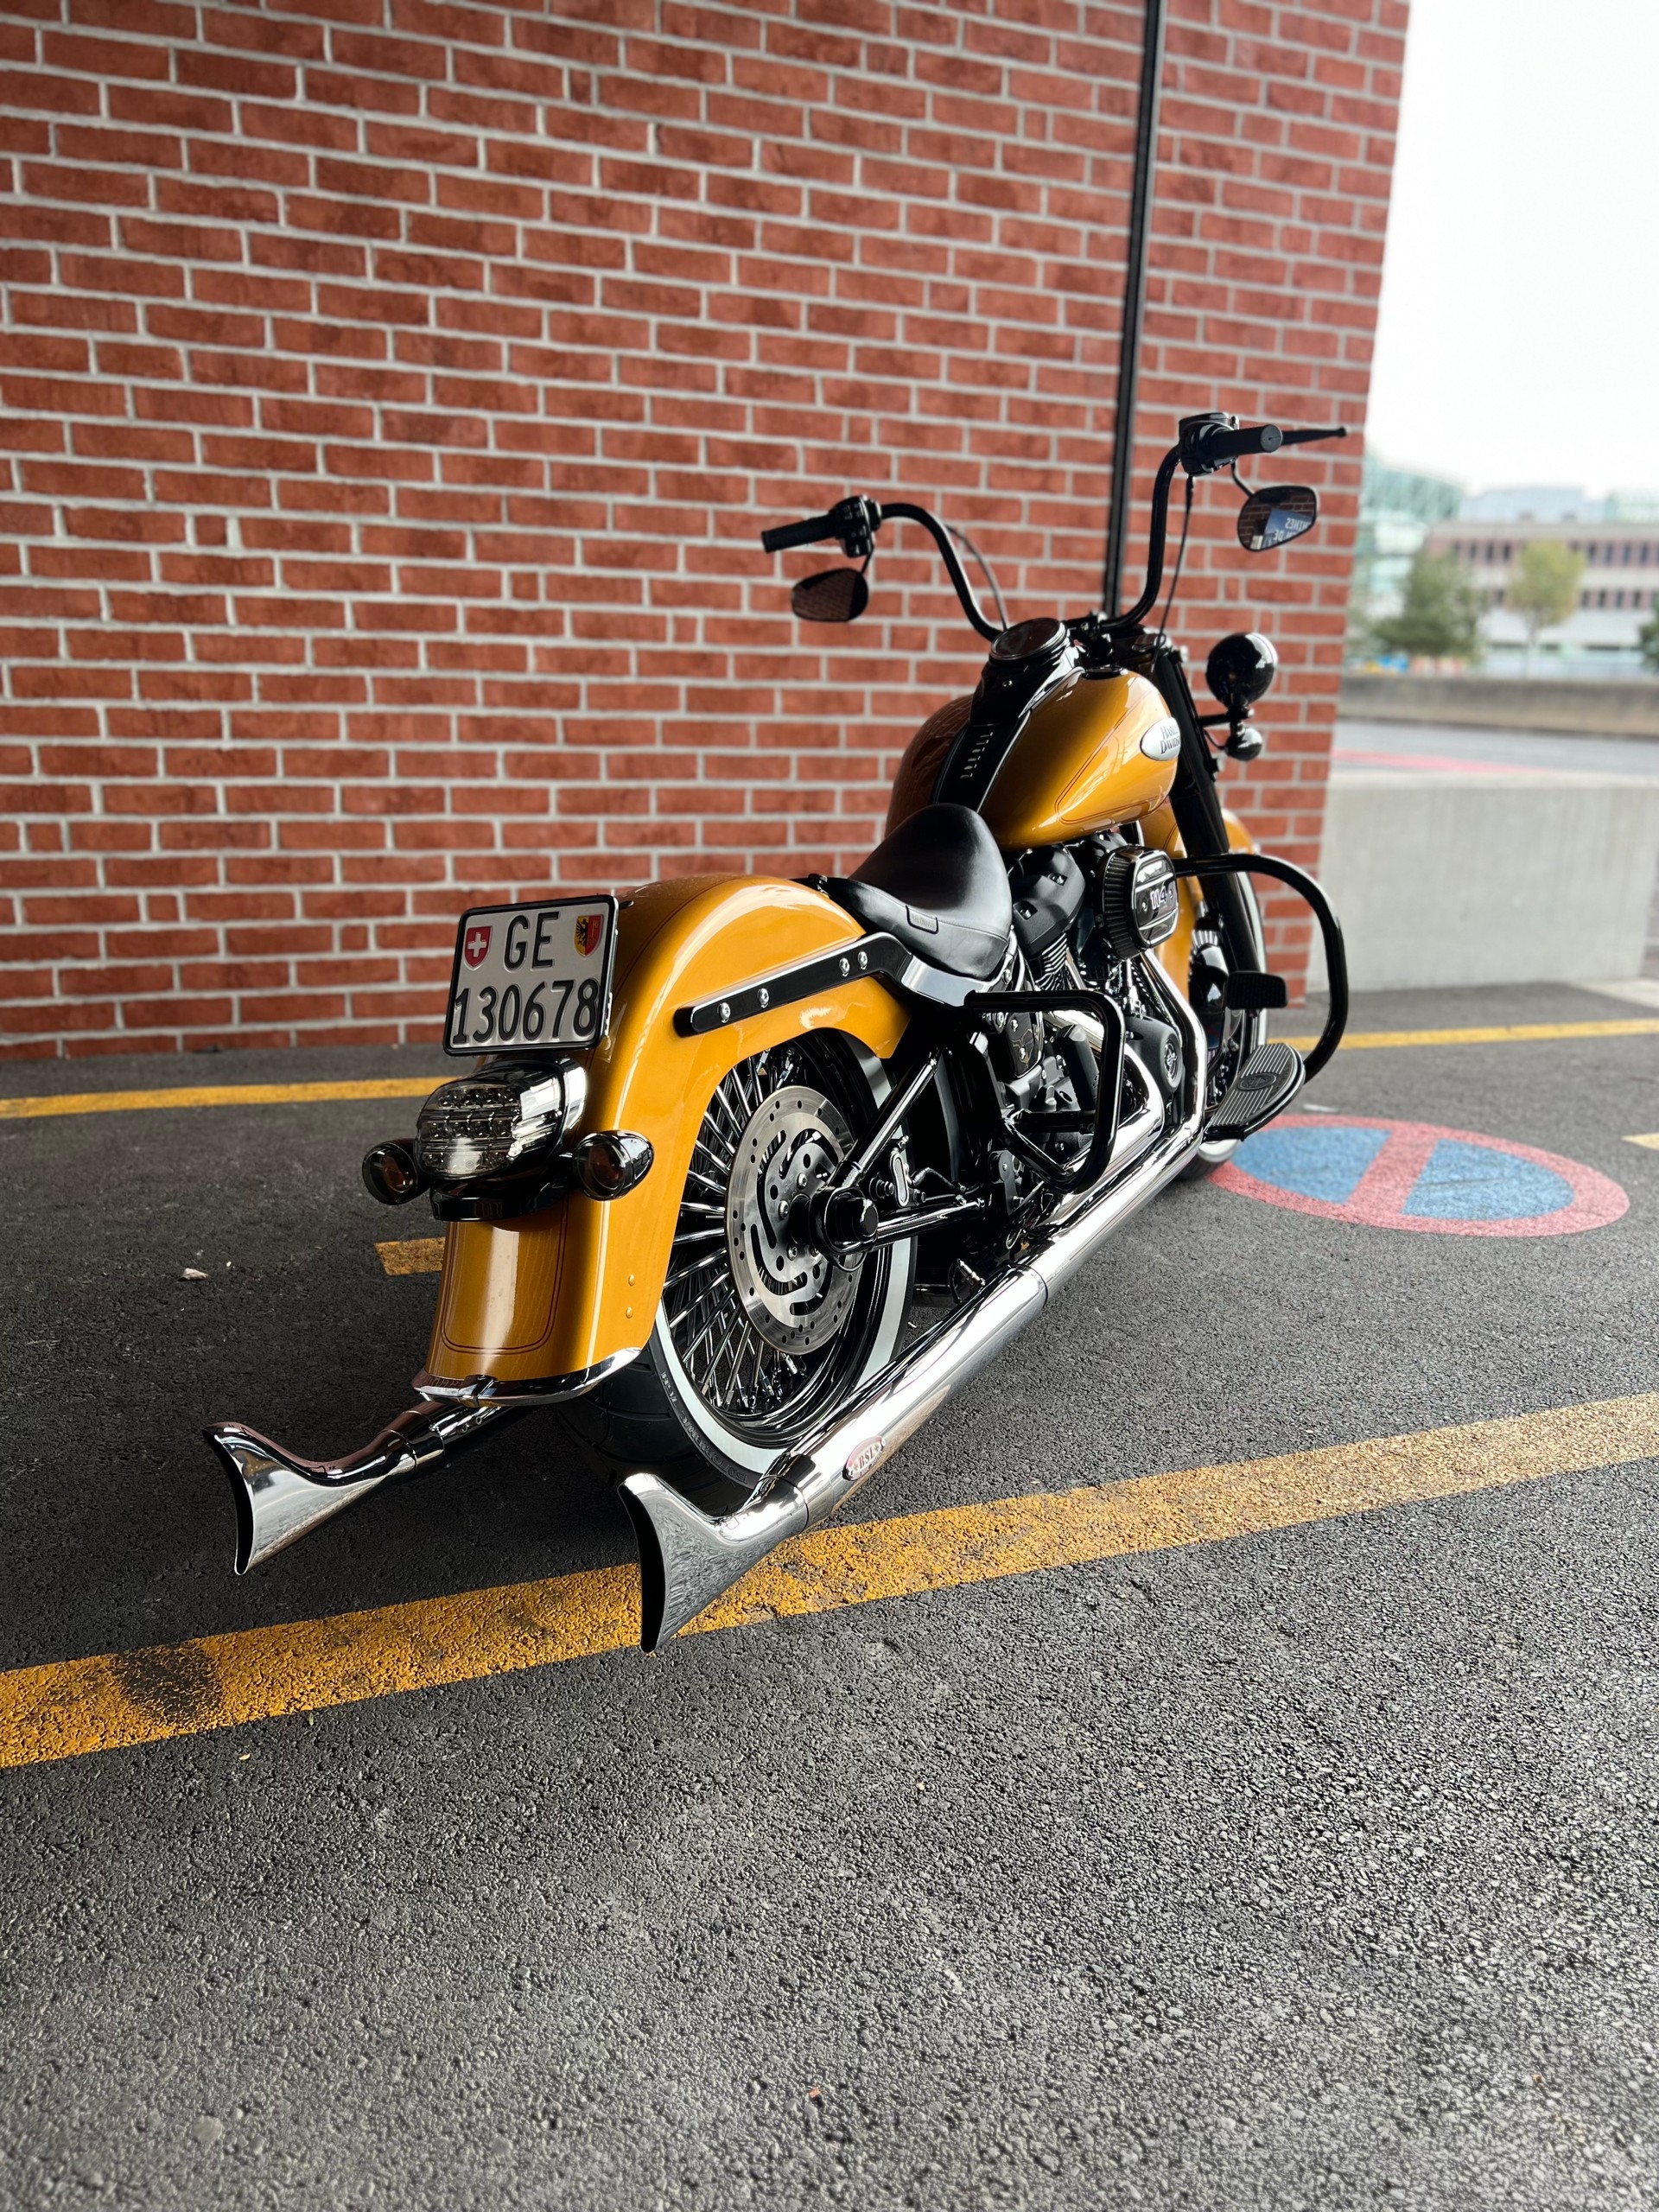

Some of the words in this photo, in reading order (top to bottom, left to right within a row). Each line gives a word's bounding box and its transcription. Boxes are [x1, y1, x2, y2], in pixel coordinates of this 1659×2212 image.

[1150, 886, 1168, 910] 114
[504, 911, 560, 970] GE
[452, 978, 600, 1044] 130678
[859, 1446, 875, 1469] BSL
